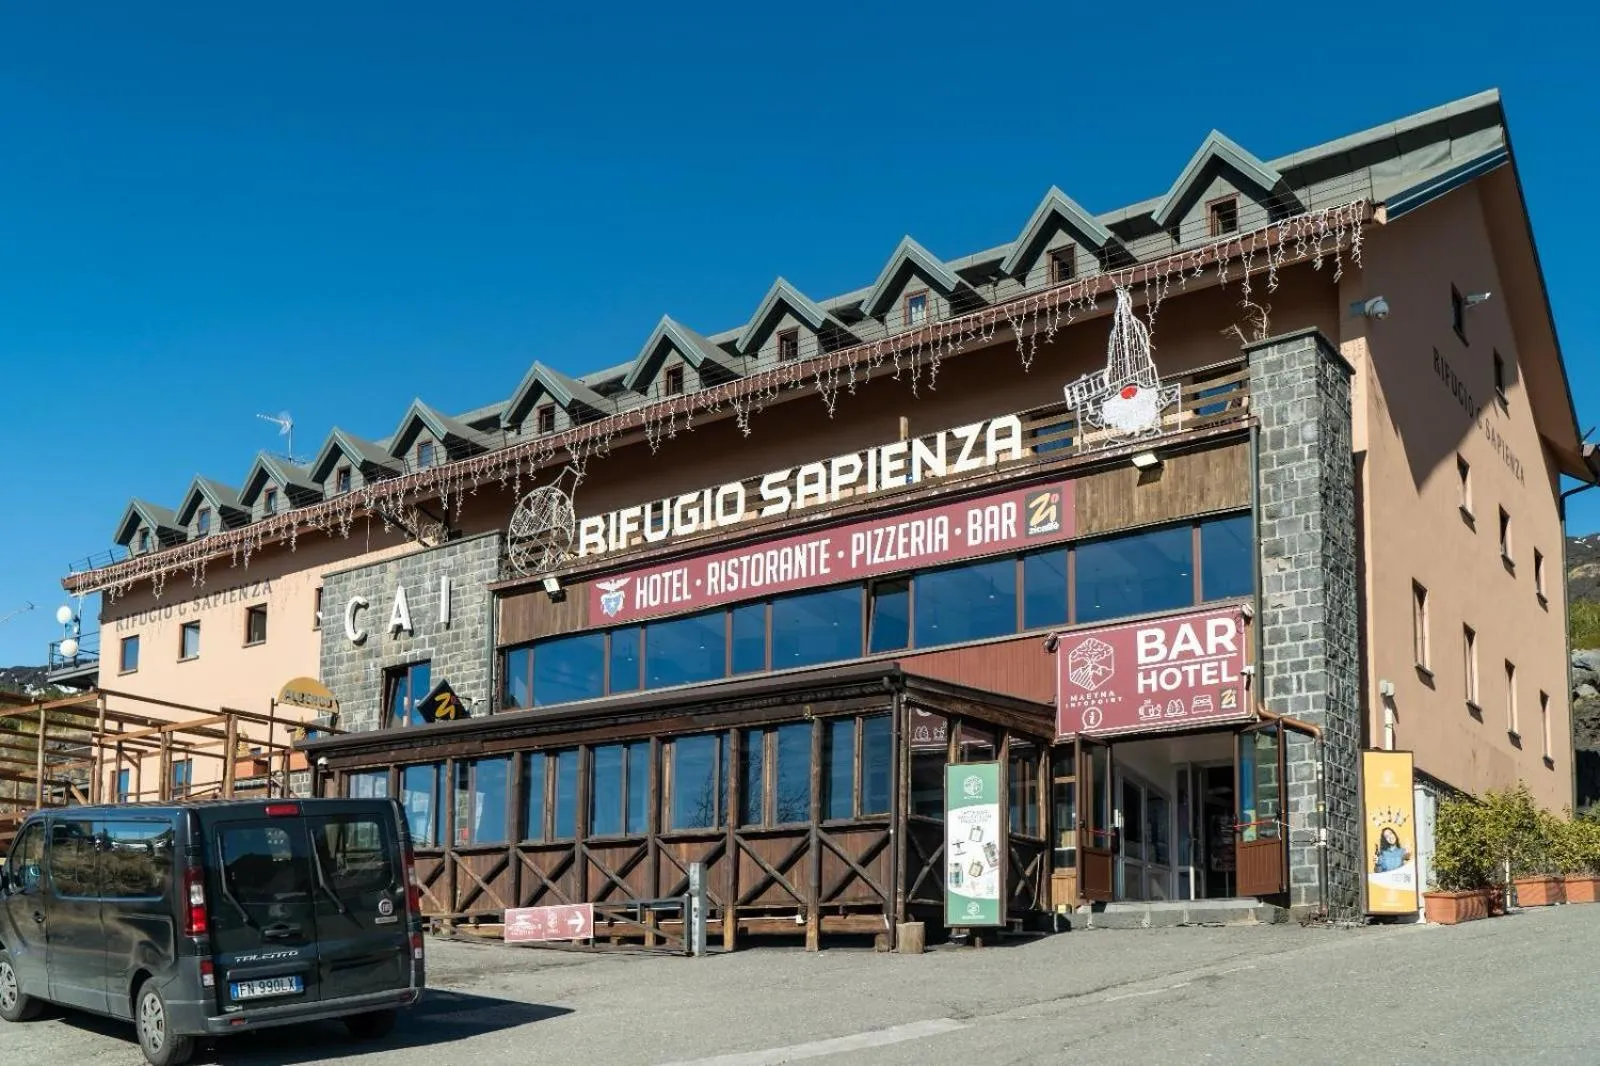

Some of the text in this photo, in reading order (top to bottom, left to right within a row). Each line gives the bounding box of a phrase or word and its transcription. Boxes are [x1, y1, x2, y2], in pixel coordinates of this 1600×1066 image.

[759, 414, 1022, 518] SAPIENZA
[635, 501, 1017, 610] HOTEL RISTORANTE PIZZERIA BAR
[1136, 617, 1238, 665] BAR
[1137, 660, 1239, 694] HOTEL
[239, 977, 295, 996] FN 990LX
